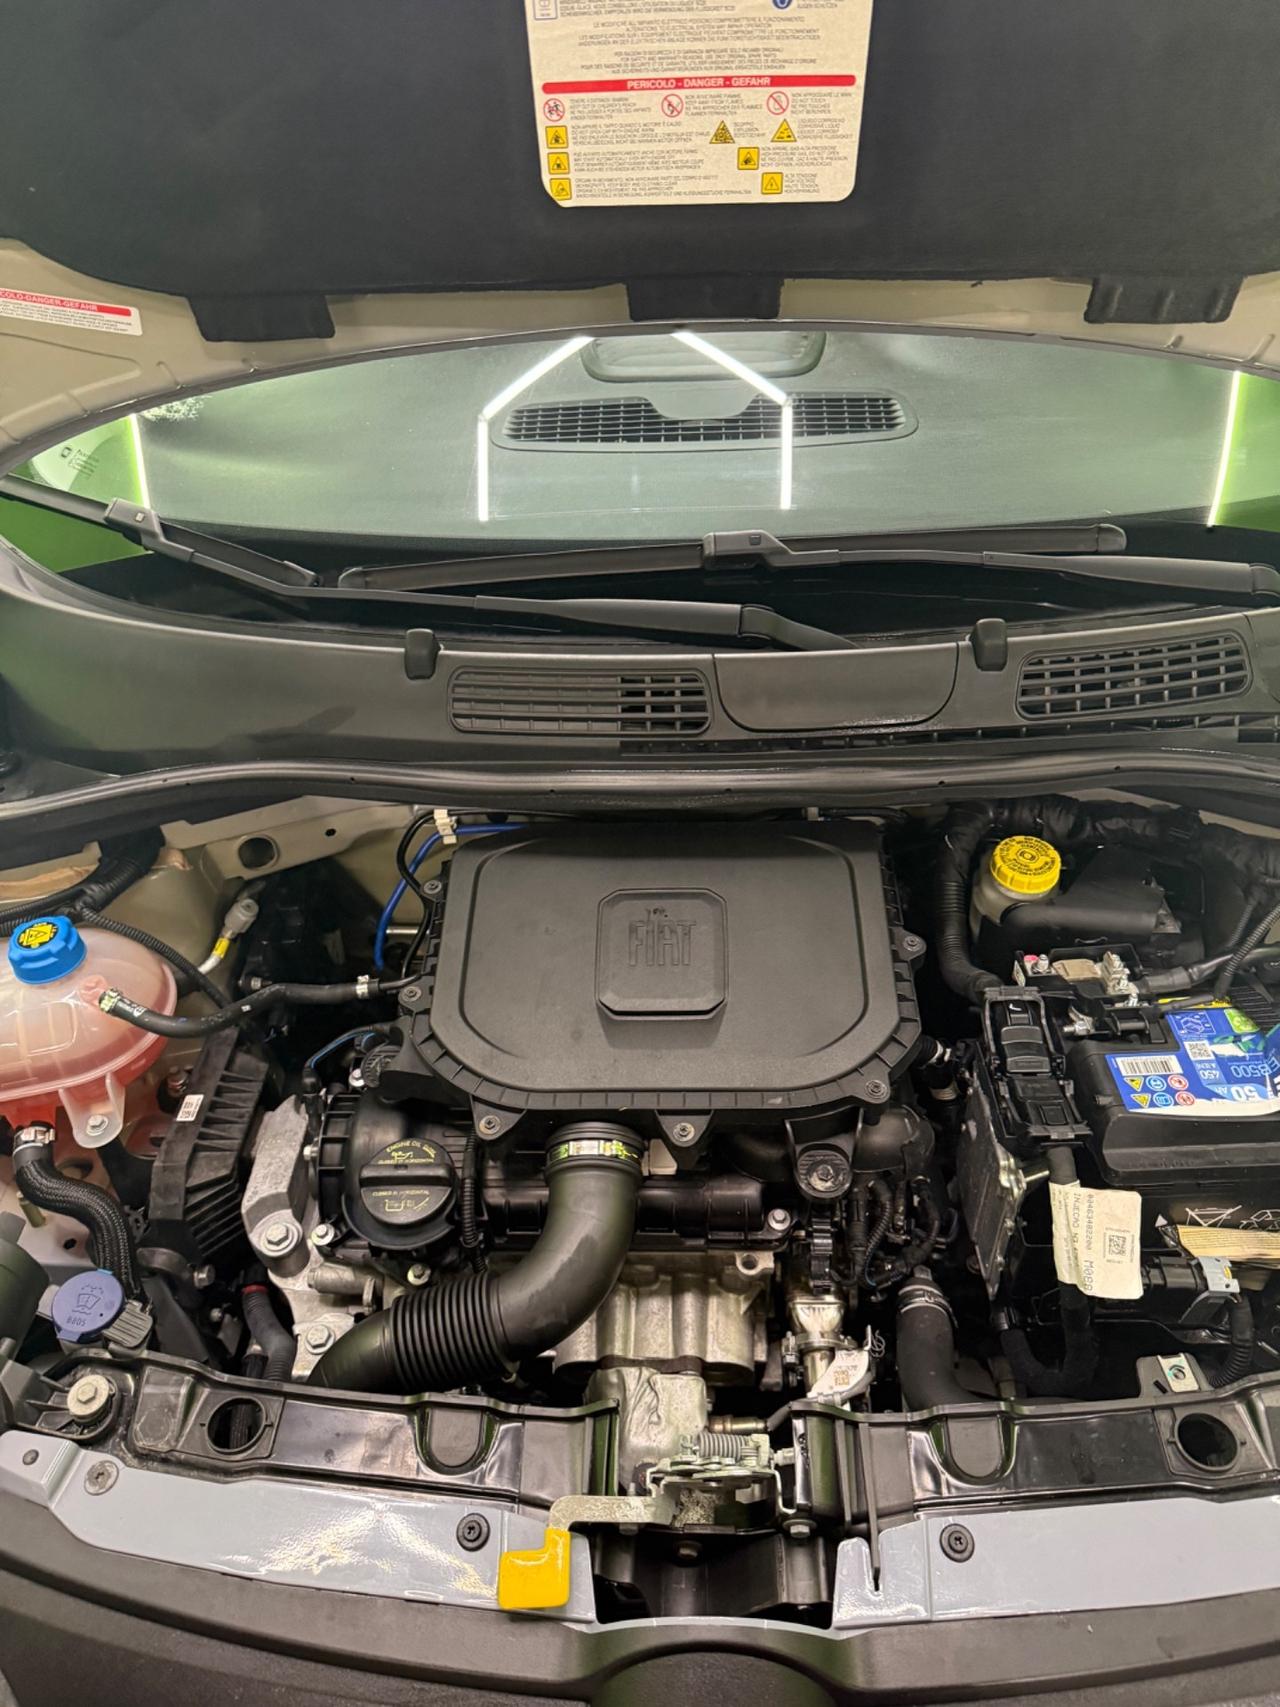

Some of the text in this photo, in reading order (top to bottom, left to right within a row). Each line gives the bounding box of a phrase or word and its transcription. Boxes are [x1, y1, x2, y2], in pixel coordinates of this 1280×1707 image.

[627, 79, 676, 90] PERICOLO
[683, 77, 725, 88] DANGER
[731, 76, 771, 87] GEFAHR
[628, 920, 697, 967] FIAT
[1200, 1070, 1220, 1080] 450
[1230, 1056, 1280, 1078] EB500
[1231, 1085, 1261, 1101] 50
